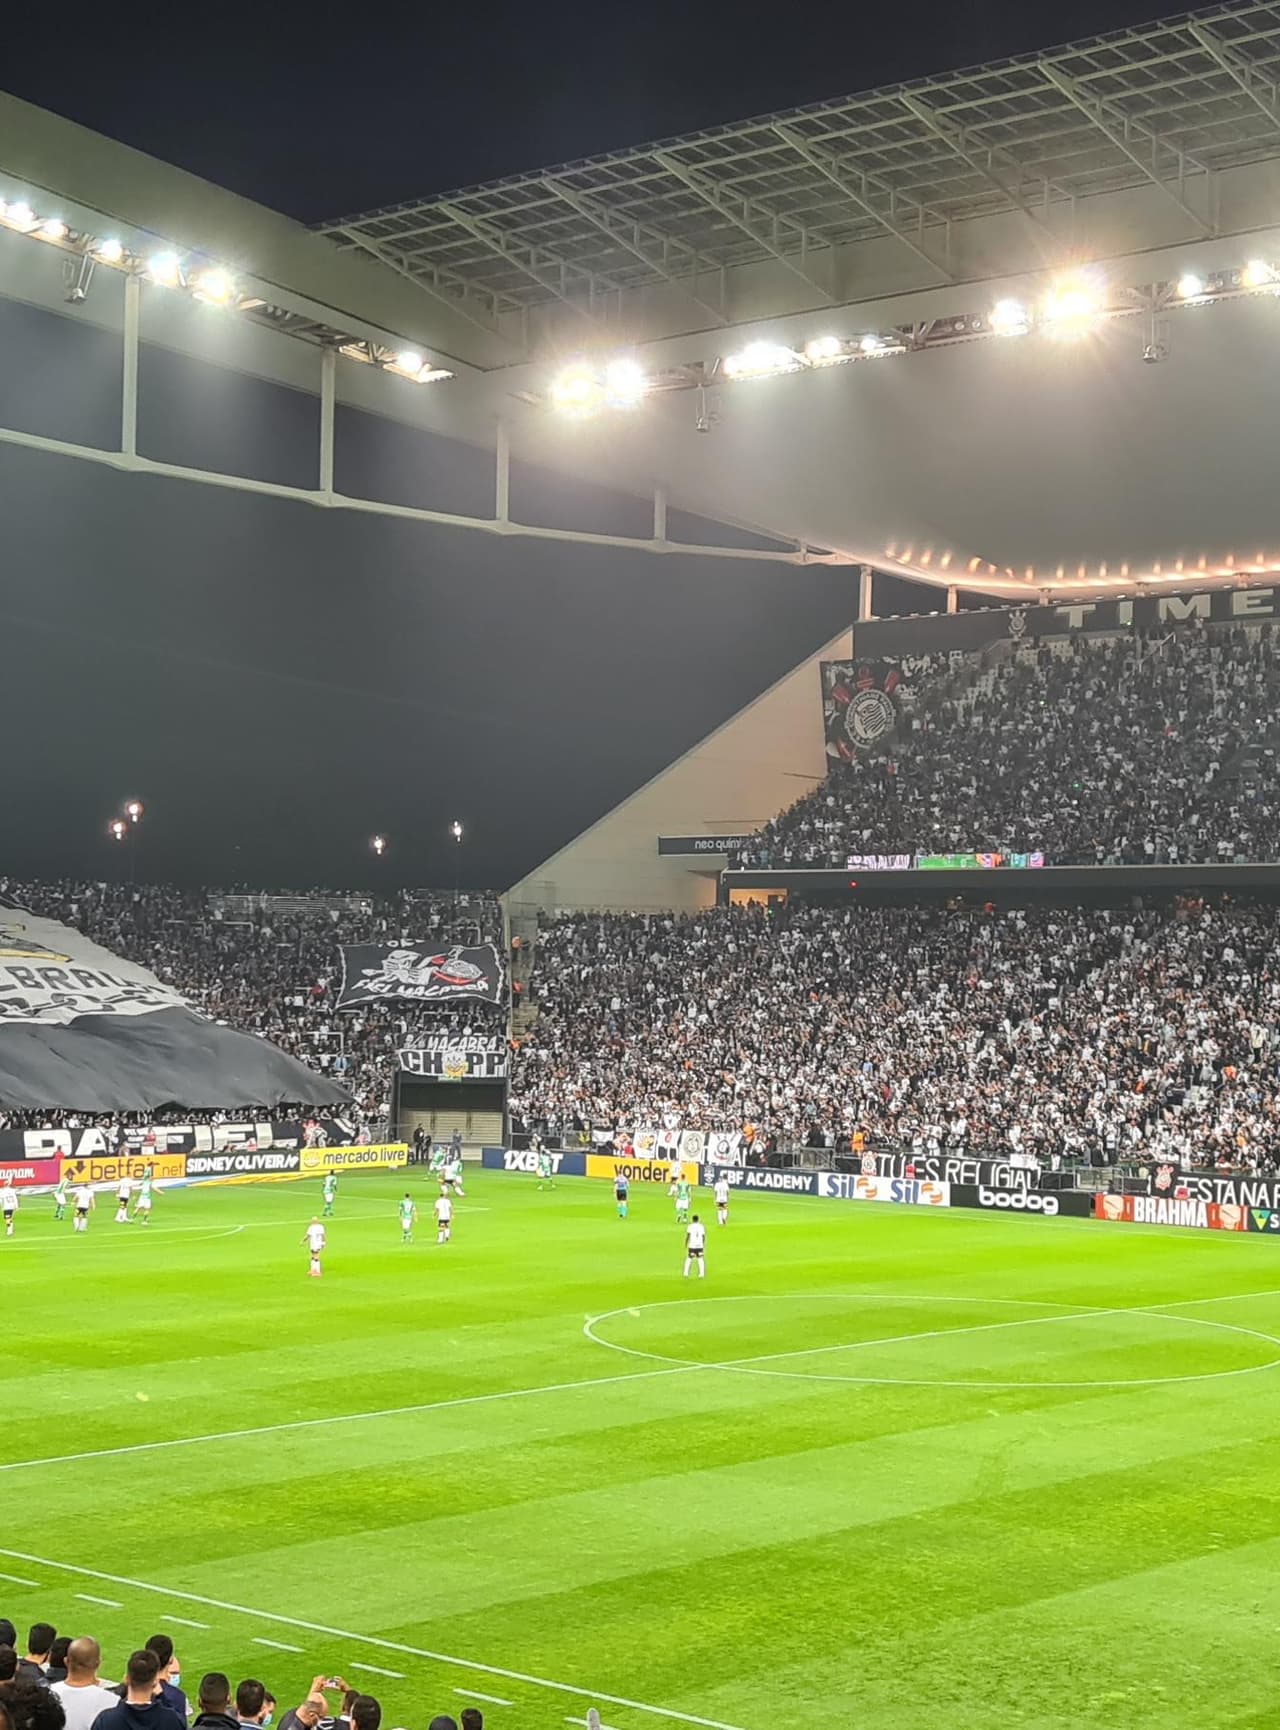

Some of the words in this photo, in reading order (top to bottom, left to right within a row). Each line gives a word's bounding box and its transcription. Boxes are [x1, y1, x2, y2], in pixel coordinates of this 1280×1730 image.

[1054, 588, 1275, 628] TIME
[187, 1157, 234, 1173] SIDNEY
[322, 1151, 378, 1165] mercado
[380, 1148, 405, 1162] livre
[504, 1150, 563, 1171] 1XBT
[719, 1169, 754, 1187] CBF
[757, 1171, 813, 1191] ACADEMY
[827, 1174, 854, 1199] Sil
[890, 1179, 918, 1204] Sil
[979, 1185, 1058, 1215] bodog
[1134, 1197, 1208, 1227] BRAHMA
